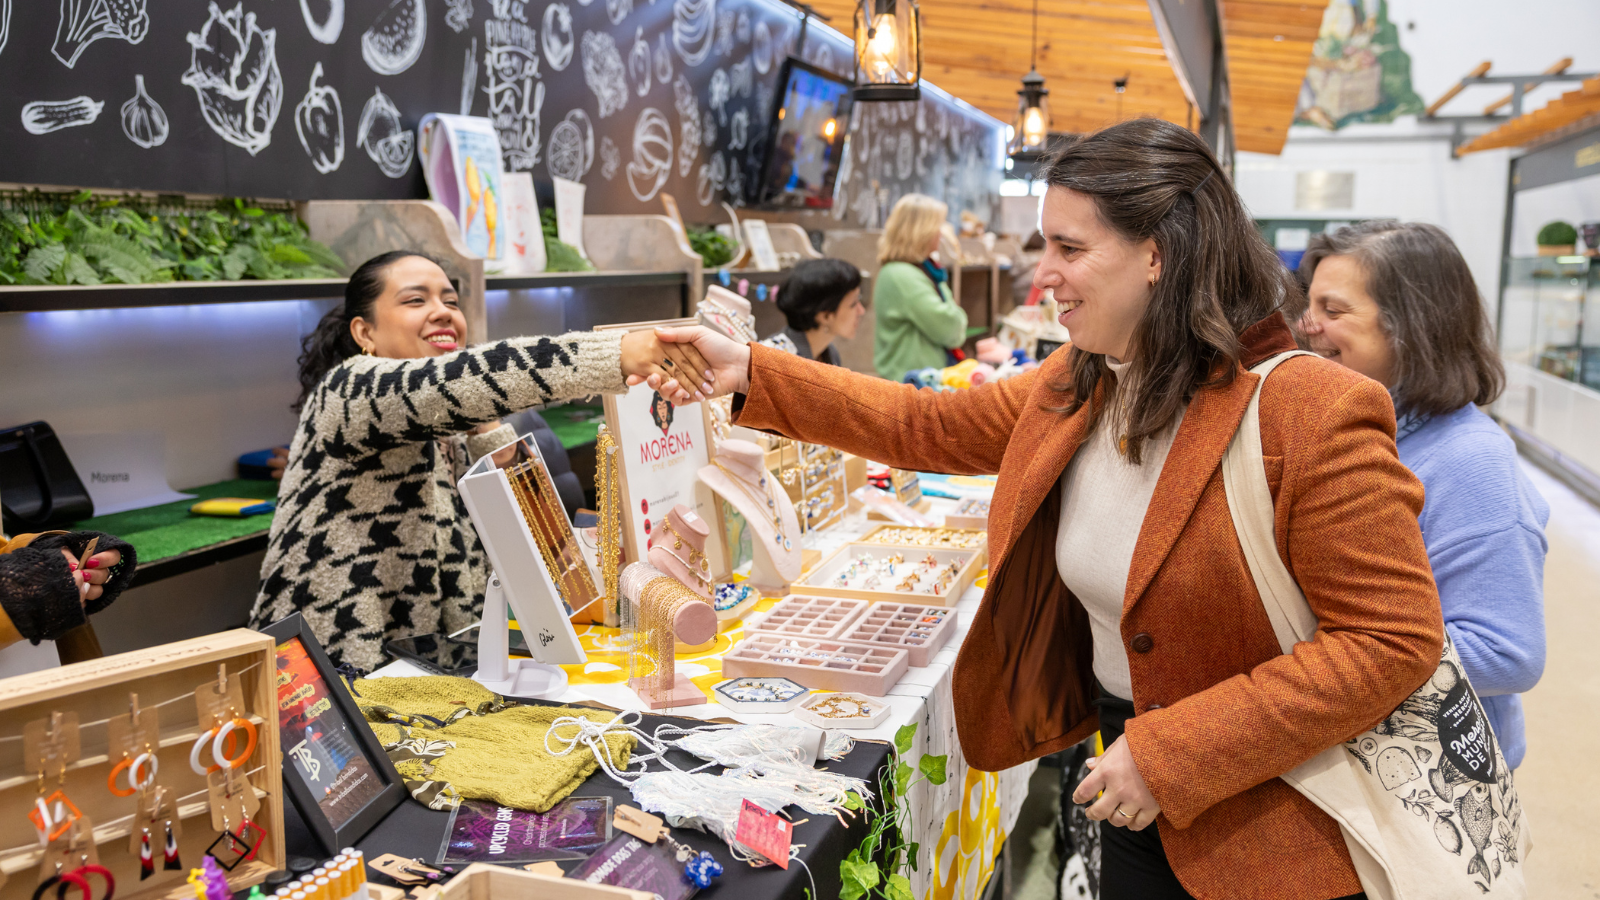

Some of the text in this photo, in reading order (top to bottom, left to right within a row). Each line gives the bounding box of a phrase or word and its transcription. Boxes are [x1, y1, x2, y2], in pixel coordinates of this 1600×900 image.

[481, 75, 545, 120] tall
[640, 431, 694, 464] MORENA
[91, 471, 130, 483] Morena
[1469, 752, 1486, 771] DE
[488, 822, 511, 855] UPCYCLED
